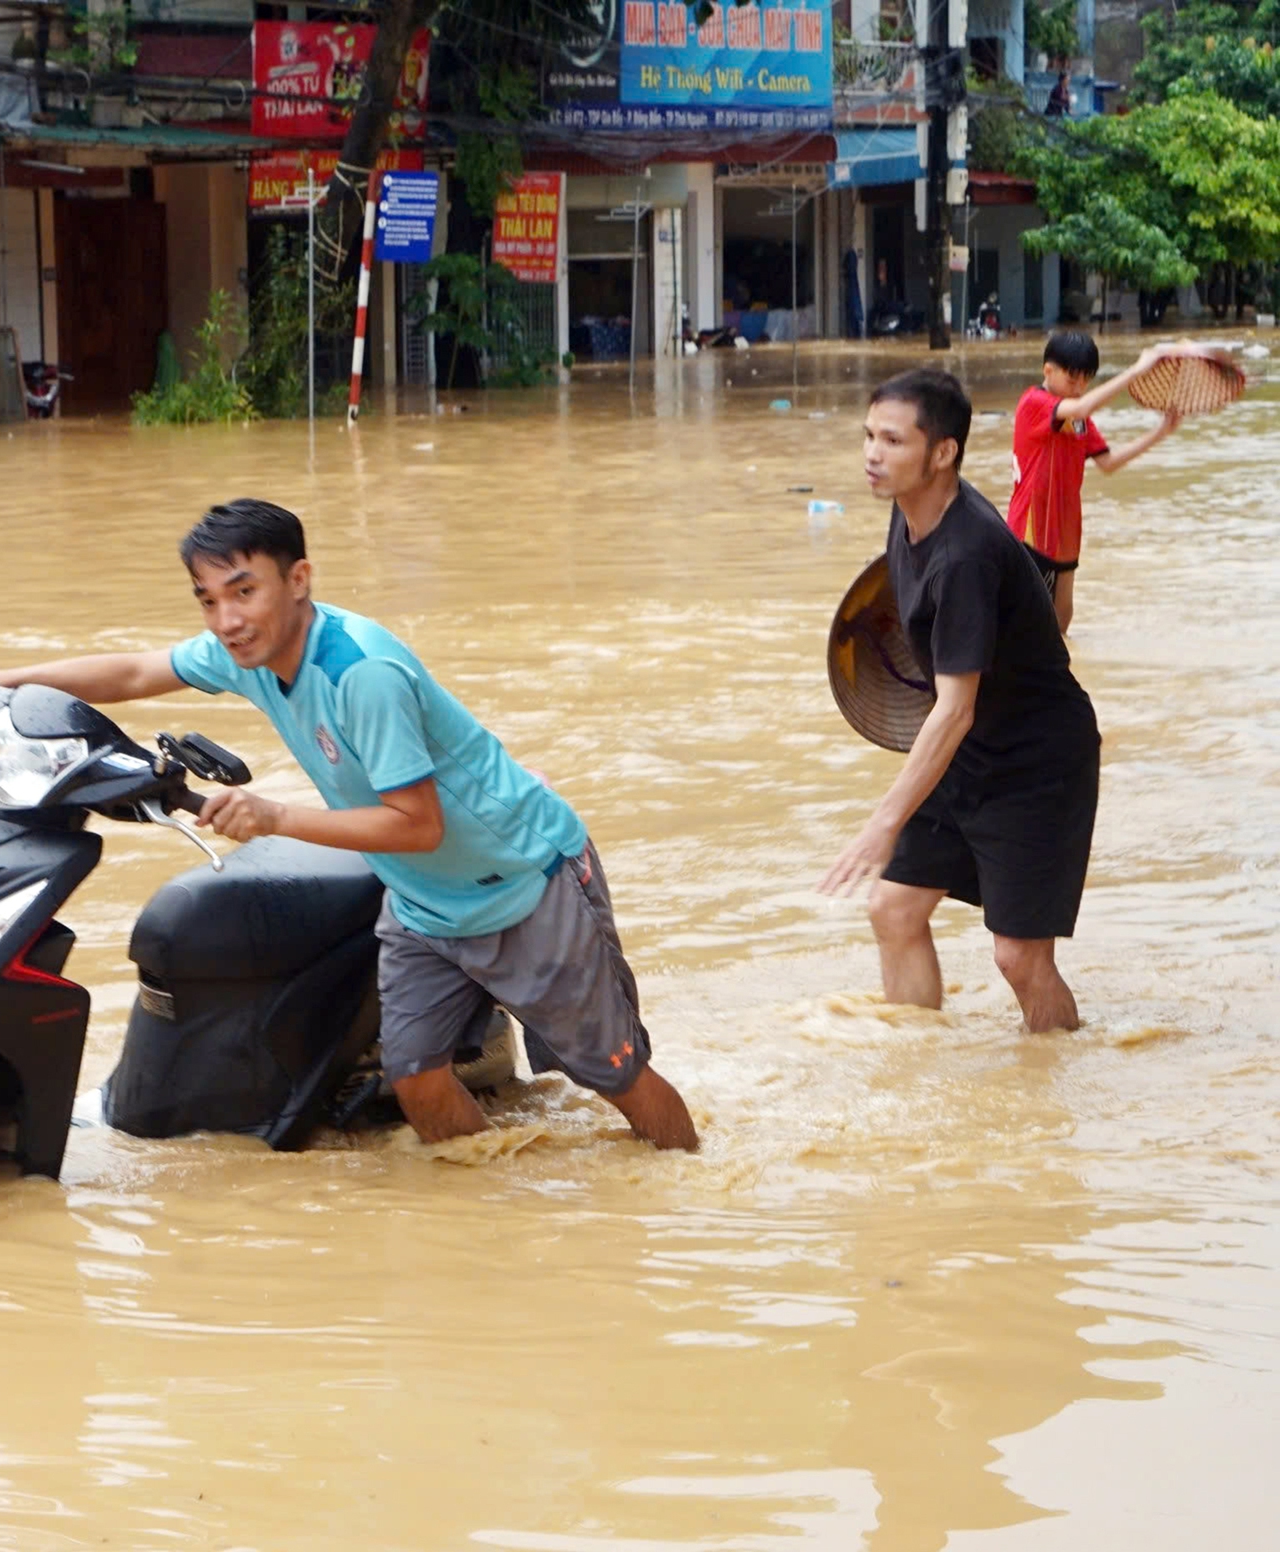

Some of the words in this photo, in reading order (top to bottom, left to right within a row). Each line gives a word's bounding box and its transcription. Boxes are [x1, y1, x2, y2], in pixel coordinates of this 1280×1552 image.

[624, 2, 656, 47] MUA
[640, 64, 662, 94] Hệ
[665, 65, 712, 95] Thống
[757, 68, 811, 94] Camera
[253, 177, 289, 199] HÀNG
[500, 214, 527, 238] THÁI
[529, 217, 553, 239] LAN
